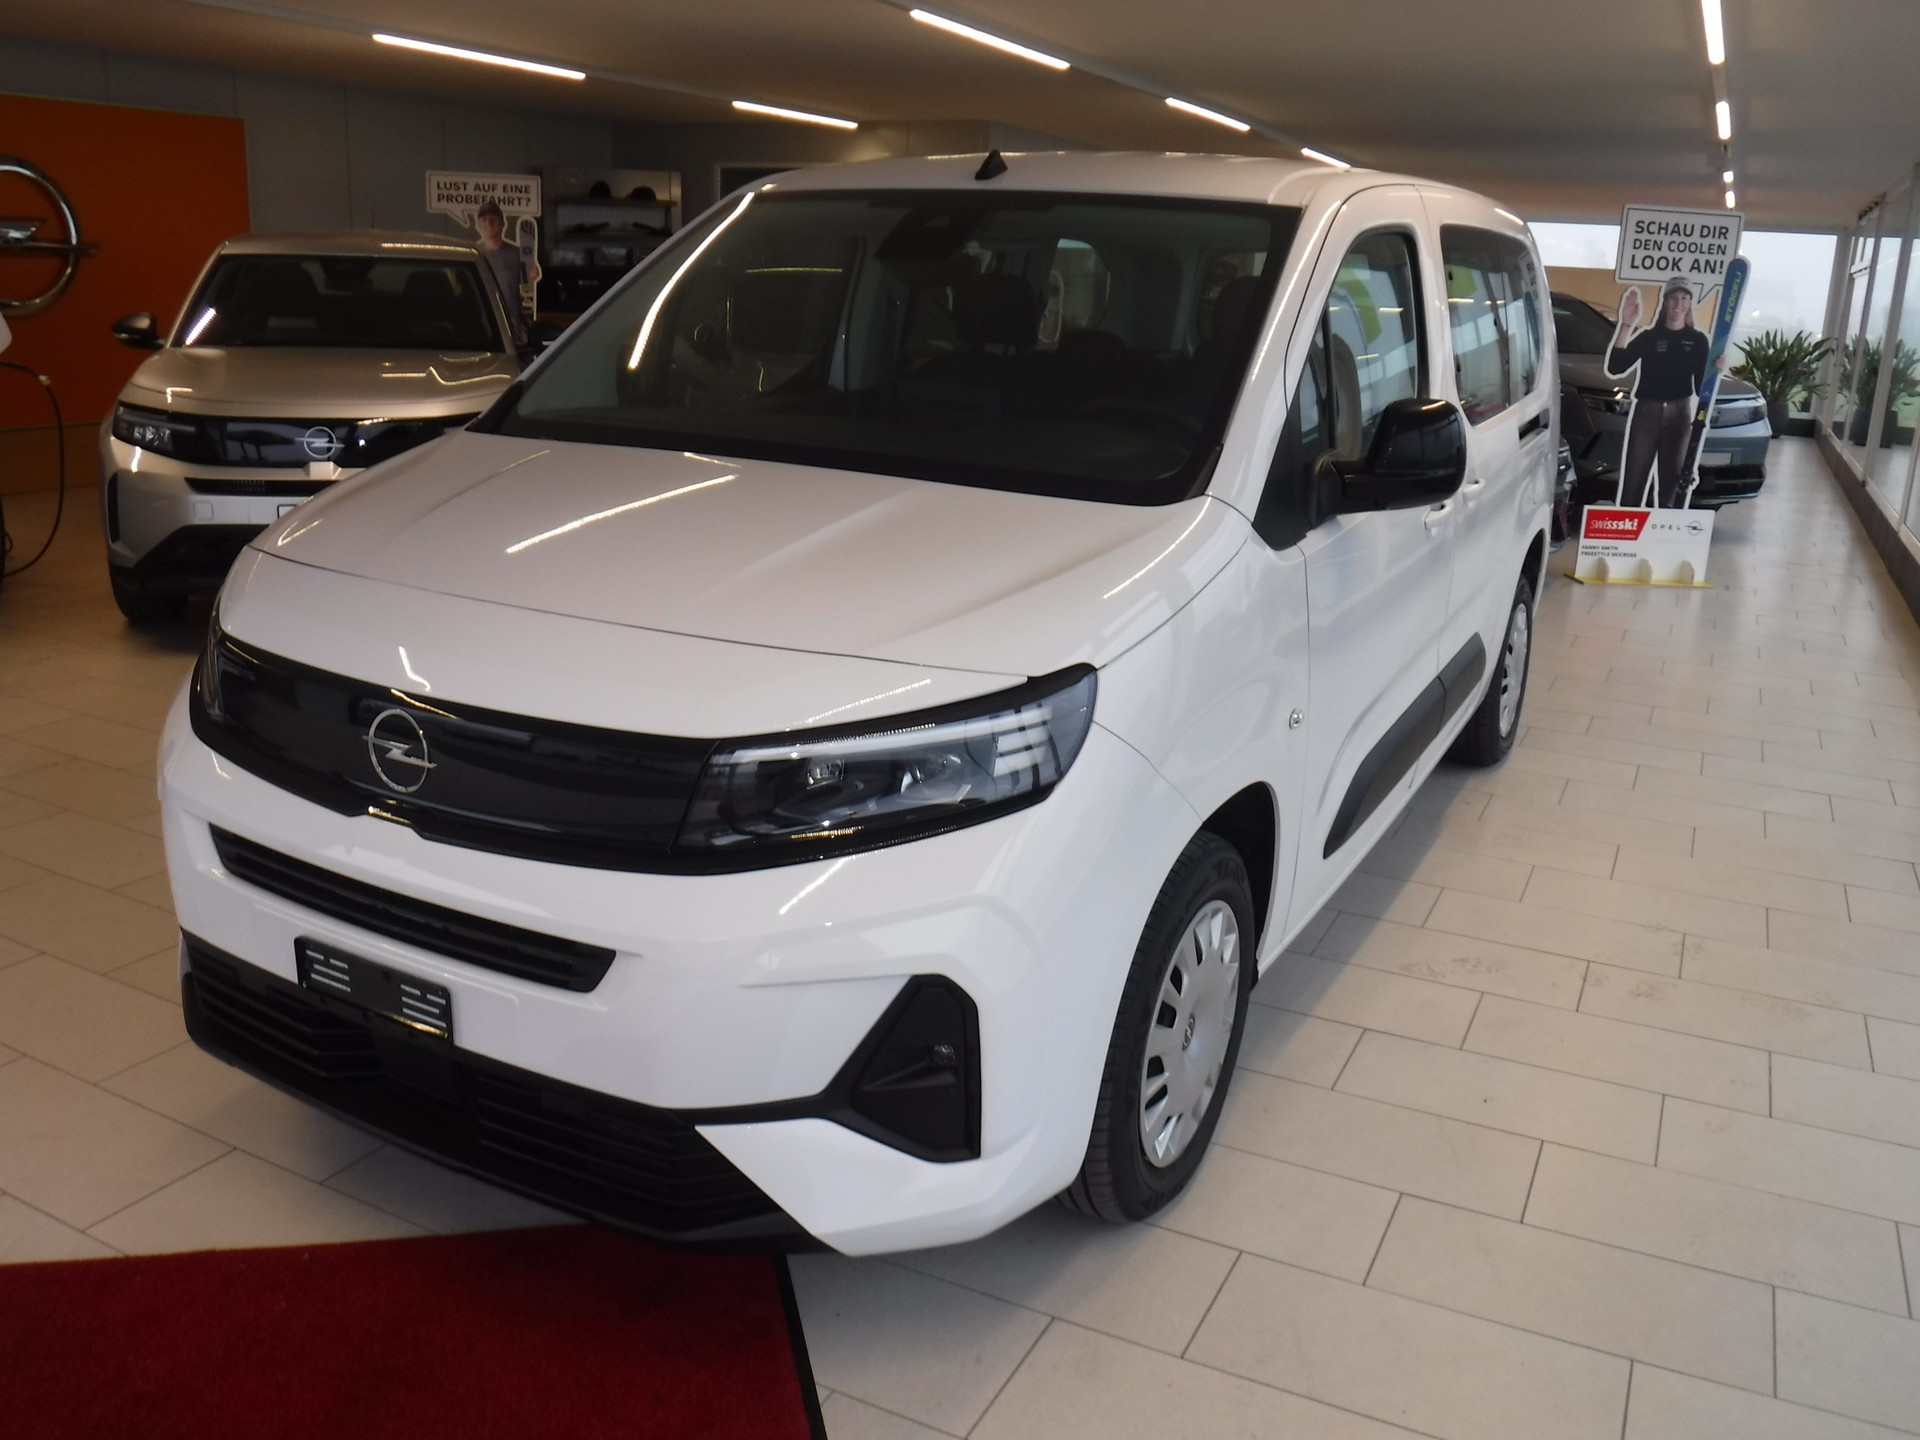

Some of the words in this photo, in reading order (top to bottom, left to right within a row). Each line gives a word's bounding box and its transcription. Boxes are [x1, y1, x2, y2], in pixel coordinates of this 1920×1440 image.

[437, 181, 468, 191] LUST
[473, 182, 498, 193] AUF
[502, 183, 531, 194] EINE
[1635, 220, 1695, 238] SCHAU
[1700, 225, 1729, 240] DIR
[1632, 238, 1663, 252] DEN
[1667, 241, 1727, 256] COOLEN
[1630, 254, 1683, 272] LOOK
[1689, 258, 1724, 275] AN!
[1651, 523, 1681, 531] OPEL
